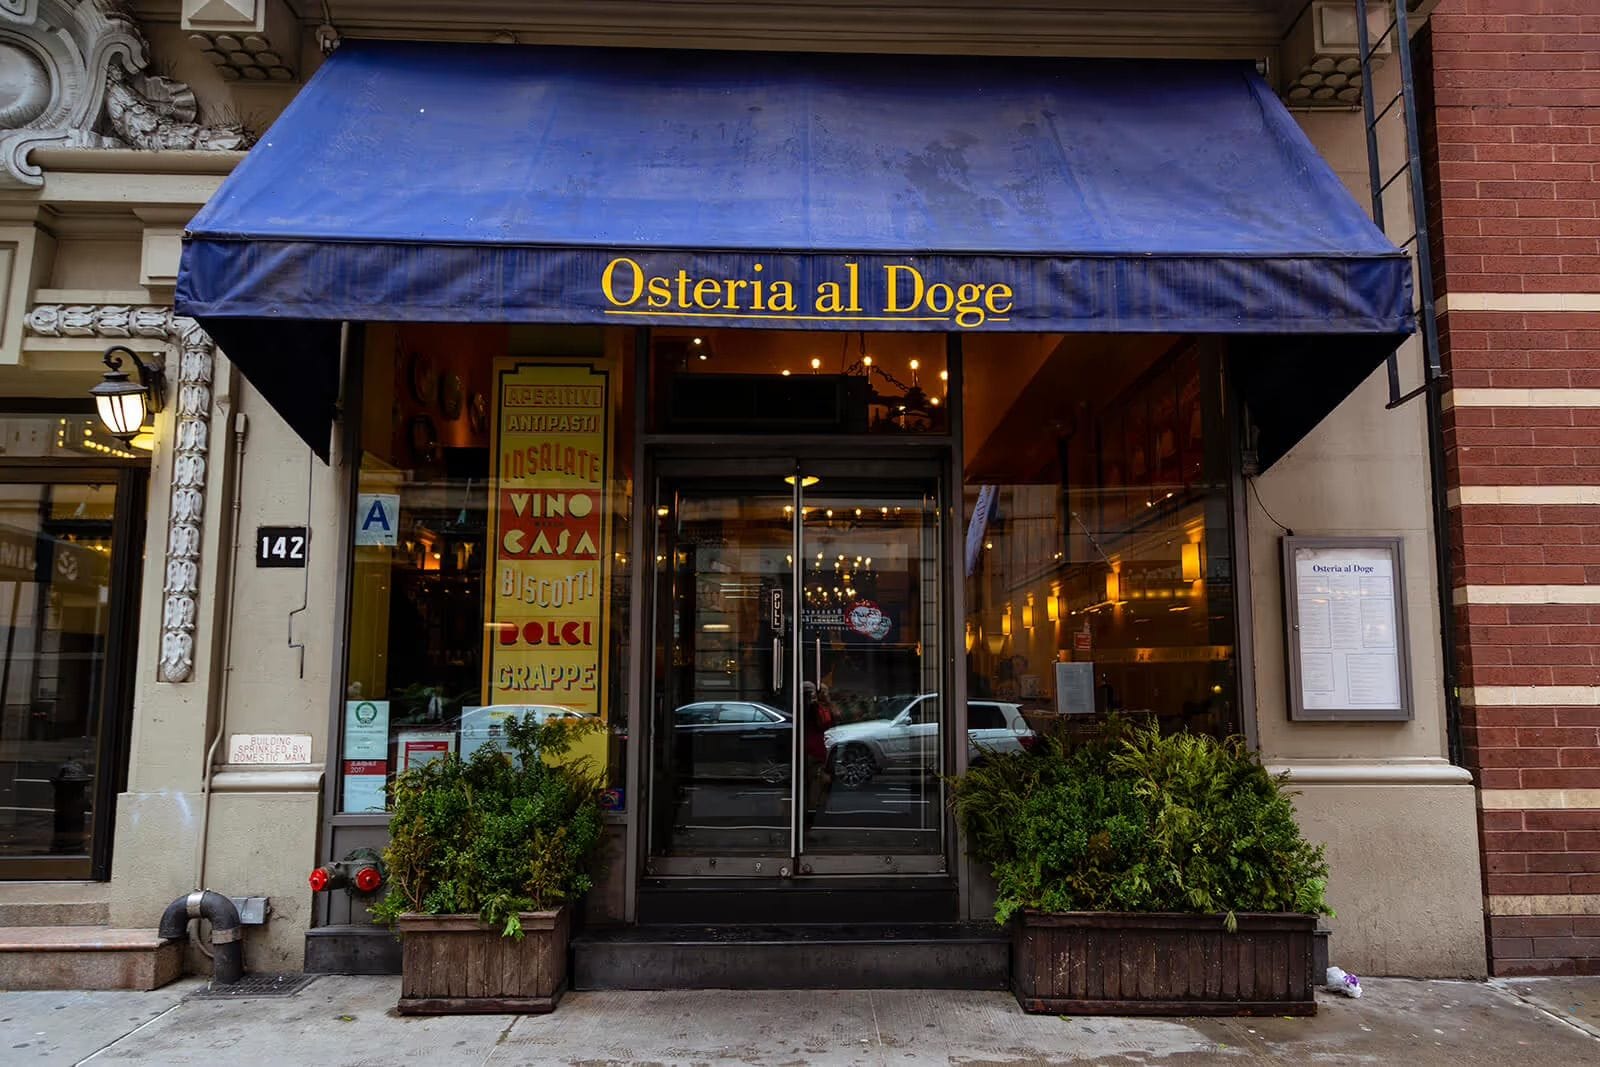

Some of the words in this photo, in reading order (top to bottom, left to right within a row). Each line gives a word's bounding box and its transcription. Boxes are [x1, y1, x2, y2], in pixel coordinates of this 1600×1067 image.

[602, 257, 797, 311] Osteria
[815, 263, 862, 313] al
[883, 265, 1013, 328] Doge
[508, 415, 597, 432] ANTIPASTI
[504, 443, 600, 483] INSALATE
[362, 500, 391, 530] A
[509, 493, 593, 518] VINO
[262, 536, 304, 559] 142
[503, 529, 597, 555] CASA
[1312, 564, 1342, 573] Osteria
[1344, 564, 1351, 573] al
[1353, 564, 1375, 574] Doge
[502, 567, 593, 608] BISCOTTI
[773, 593, 781, 626] PULL
[499, 621, 592, 645] DOLCI
[498, 663, 596, 691] GRAPPE
[238, 745, 287, 754] SPRINKLED
[292, 745, 304, 753] BY
[250, 737, 292, 745] BUILDING
[233, 753, 279, 762] DOMESTIC
[285, 753, 306, 762] MAIN
